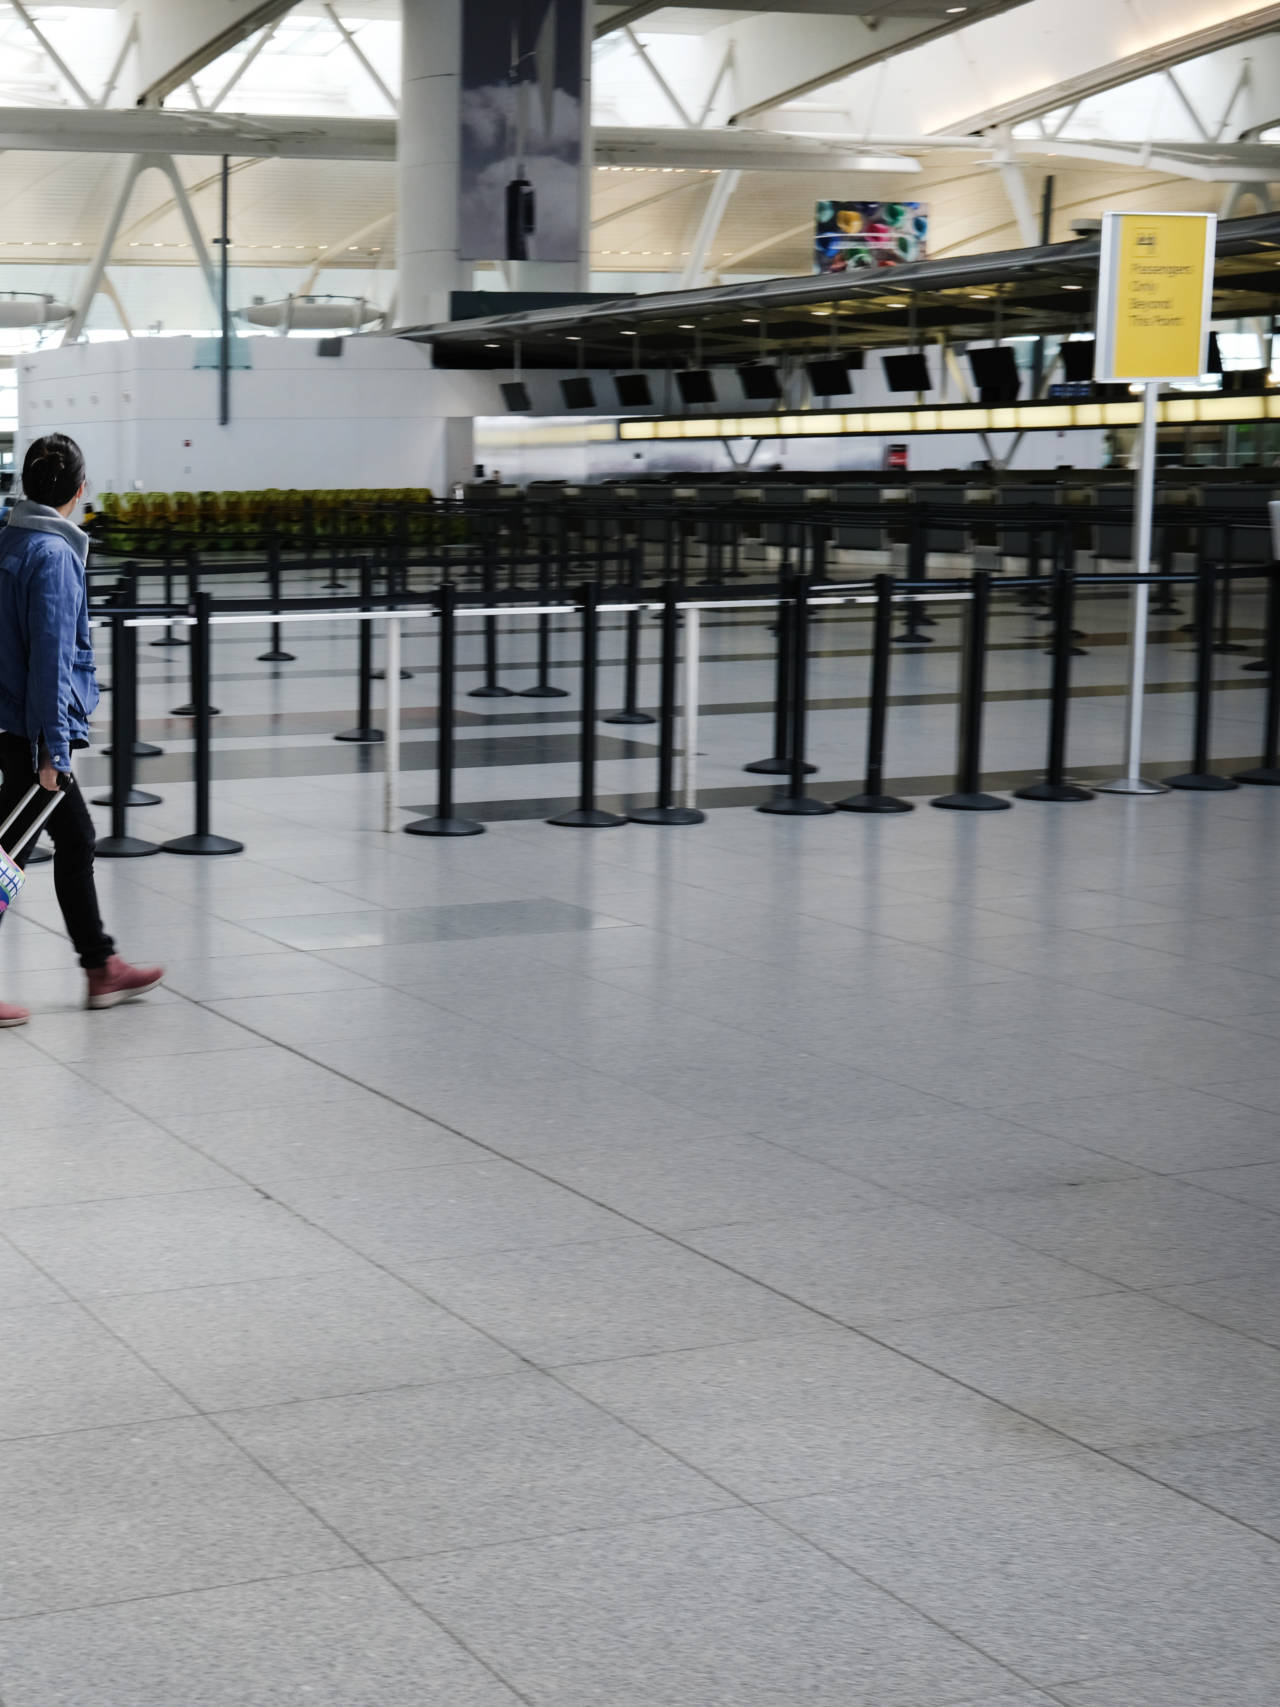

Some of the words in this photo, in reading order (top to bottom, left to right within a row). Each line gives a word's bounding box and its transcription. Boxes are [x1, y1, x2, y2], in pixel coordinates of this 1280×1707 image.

[1130, 281, 1157, 295] Only
[1129, 298, 1173, 312] Beyond
[1128, 315, 1151, 327] This
[1153, 315, 1184, 327] Point
